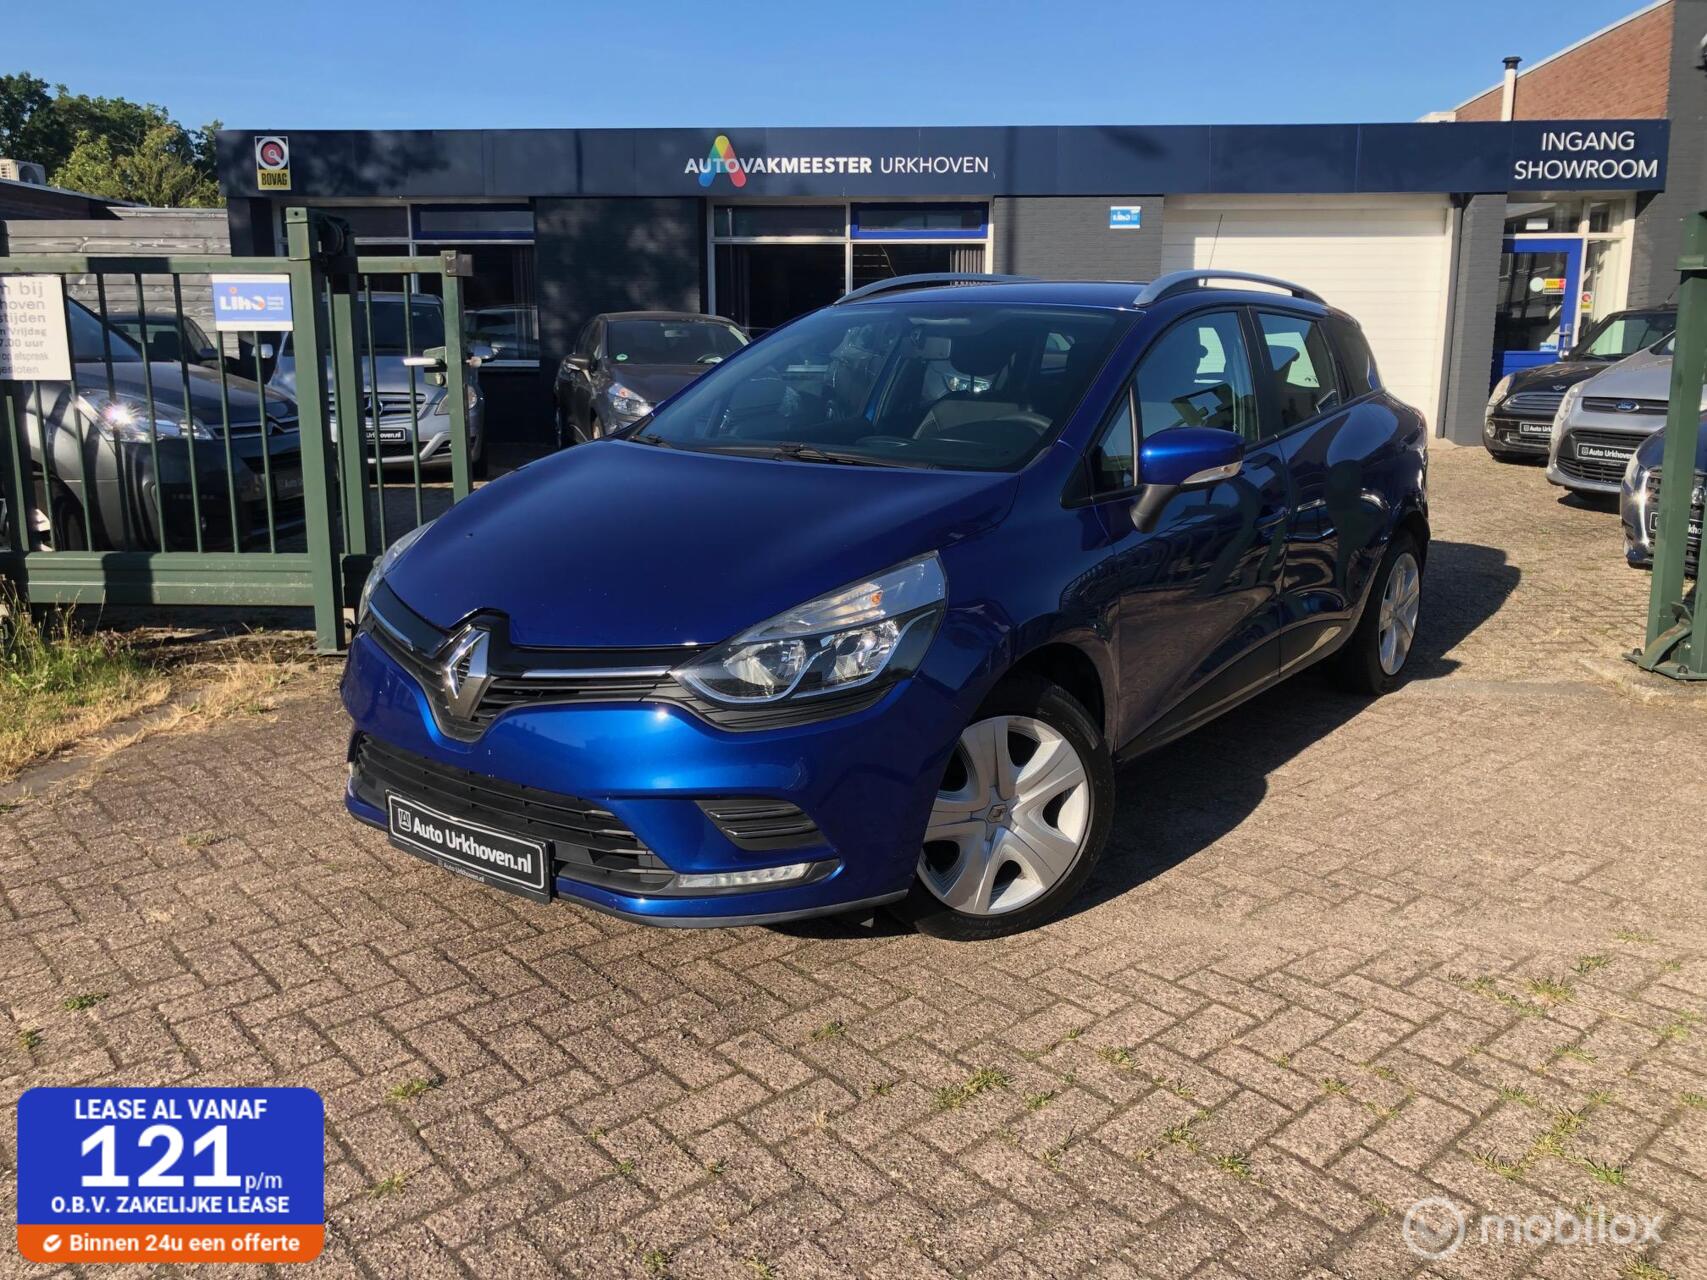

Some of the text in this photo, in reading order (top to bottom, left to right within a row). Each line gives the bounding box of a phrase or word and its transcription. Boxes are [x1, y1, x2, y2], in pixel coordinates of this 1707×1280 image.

[1541, 131, 1635, 151] INGANG
[684, 156, 989, 174] AUTOVAKMEESTER URKHOVEN
[1514, 159, 1659, 180] SHOWROOM
[261, 172, 288, 186] BOVAG
[19, 282, 43, 298] bij
[1589, 448, 1604, 457] Auto
[413, 817, 532, 874] Auto Urkhoven.nl
